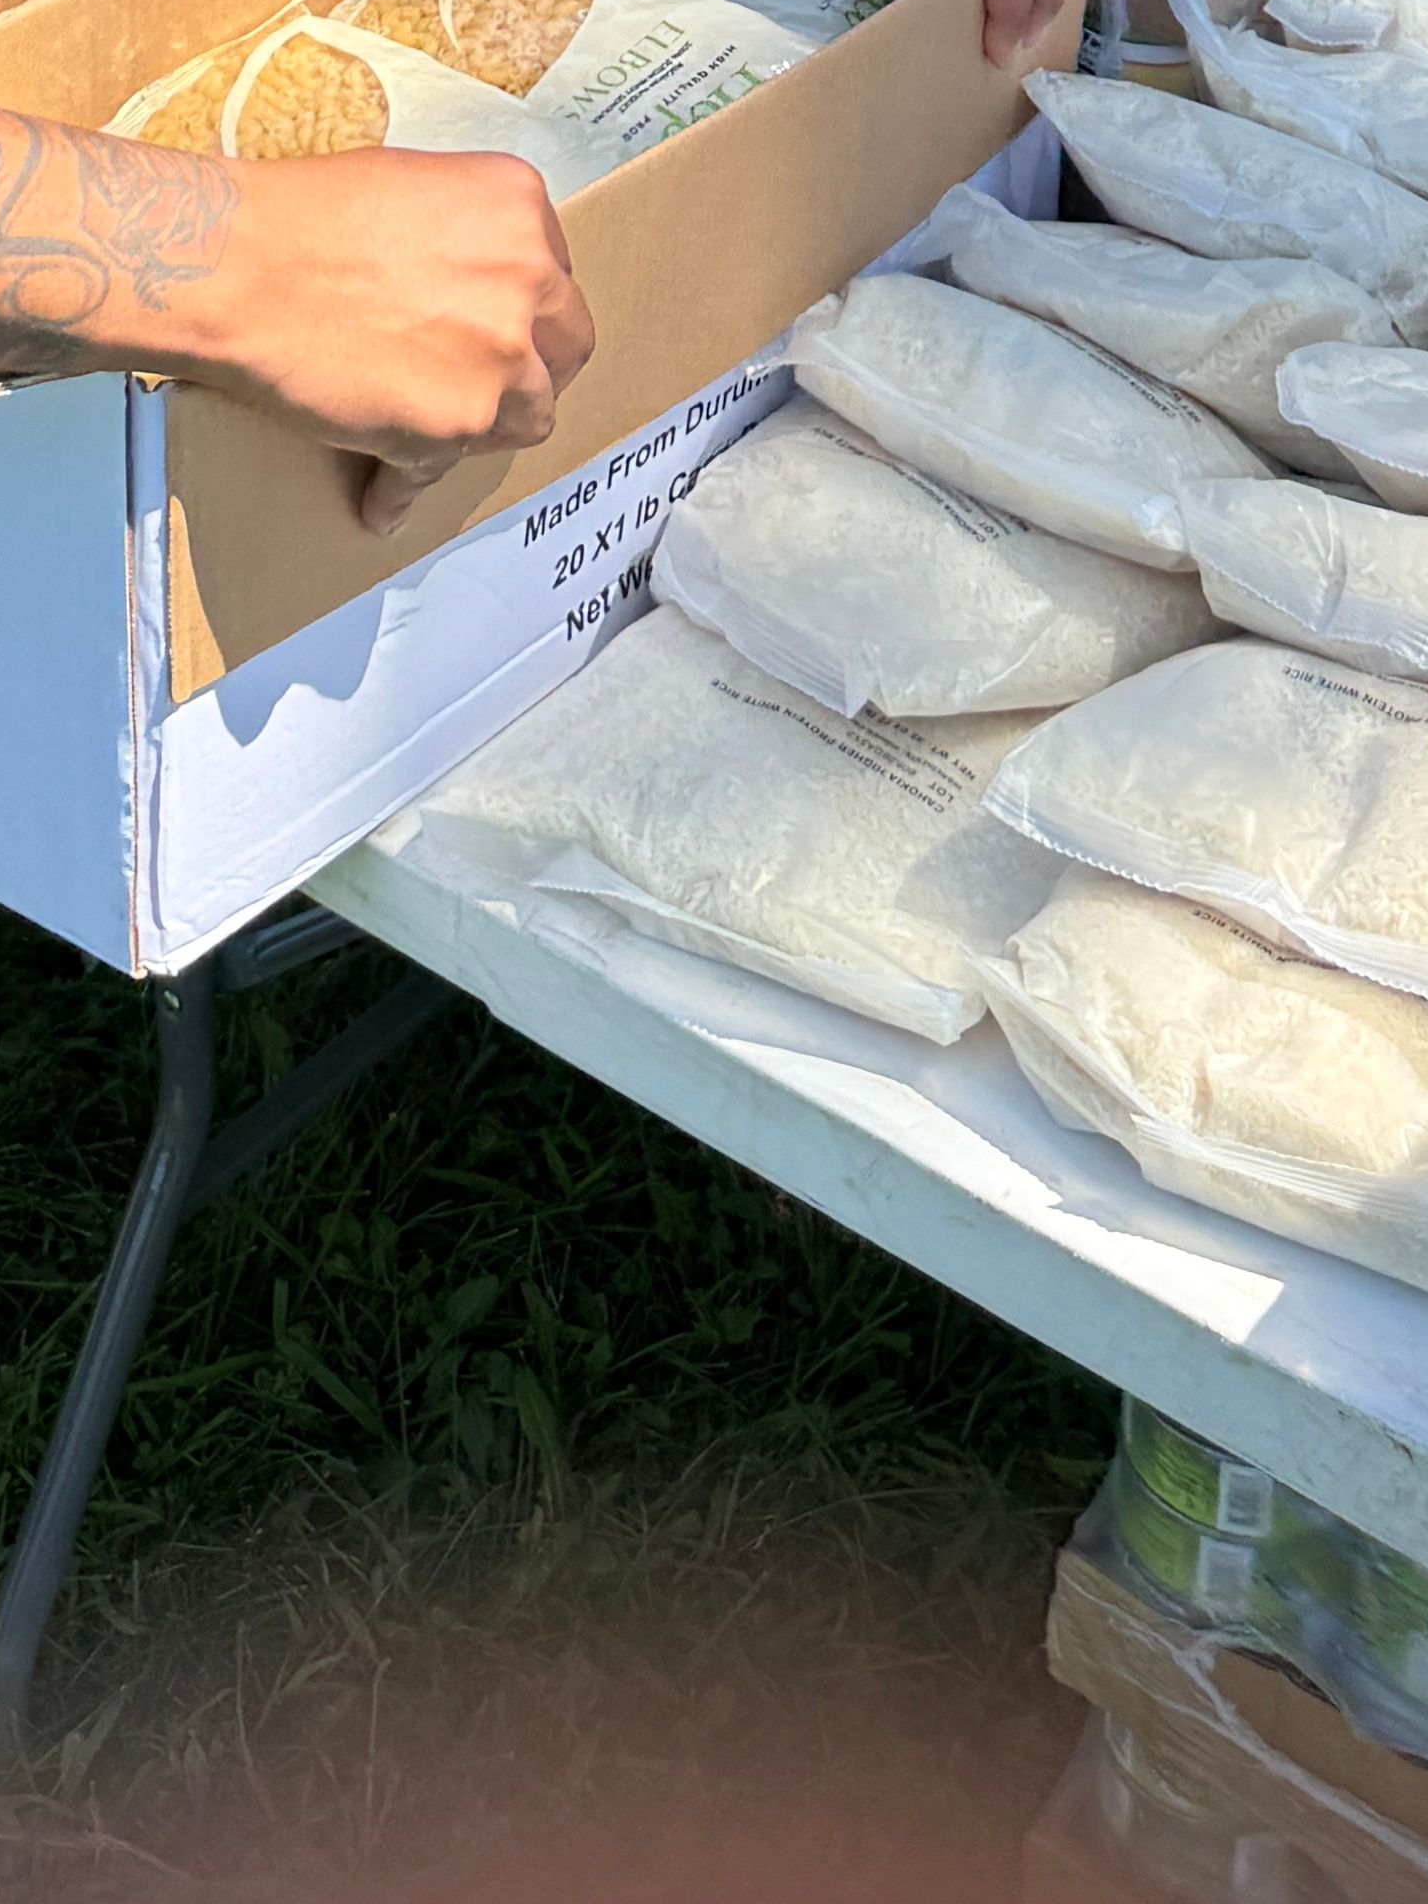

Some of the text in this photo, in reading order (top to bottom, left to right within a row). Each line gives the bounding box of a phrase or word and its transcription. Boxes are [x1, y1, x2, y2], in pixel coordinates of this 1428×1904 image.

[663, 70, 708, 107] QUALITY
[523, 479, 598, 548] Made
[607, 425, 676, 490] From
[552, 543, 585, 590] 20
[635, 494, 660, 530] lb
[567, 582, 611, 642] Net
[710, 677, 740, 700] RICE
[1282, 664, 1315, 684] RICE
[1317, 674, 1359, 699] WHITE
[743, 693, 781, 713] WHITE
[1361, 692, 1423, 725] PROTEIN
[783, 706, 837, 747] PROTEIN
[838, 741, 886, 776] HIGHER
[951, 757, 977, 782] NET
[889, 771, 945, 814] CAHOKIA
[928, 780, 955, 804] LOT
[1191, 908, 1227, 929] RICE
